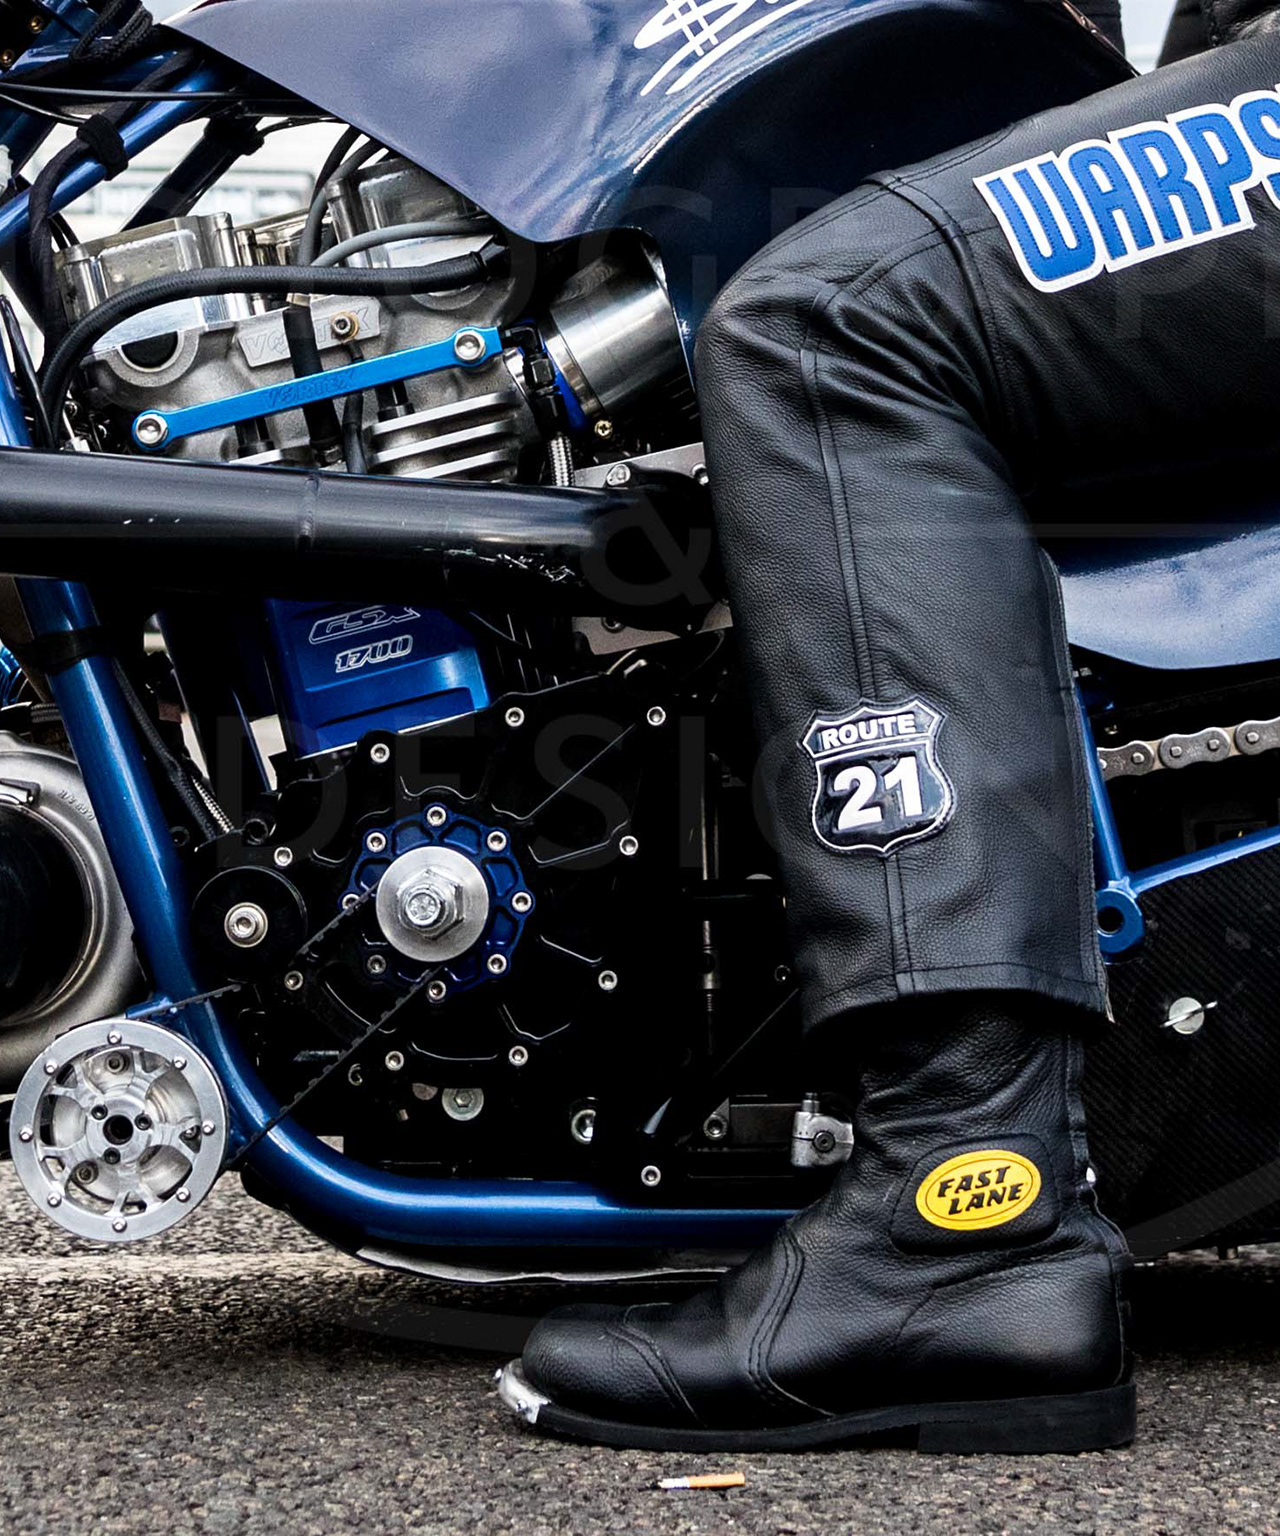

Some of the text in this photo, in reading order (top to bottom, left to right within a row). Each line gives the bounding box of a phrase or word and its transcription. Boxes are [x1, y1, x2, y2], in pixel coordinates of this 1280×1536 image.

[335, 634, 413, 673] 1700
[821, 713, 917, 751] ROUTE
[832, 755, 925, 834] 21
[936, 1166, 1010, 1199] FAST
[948, 1182, 1025, 1216] LANE
